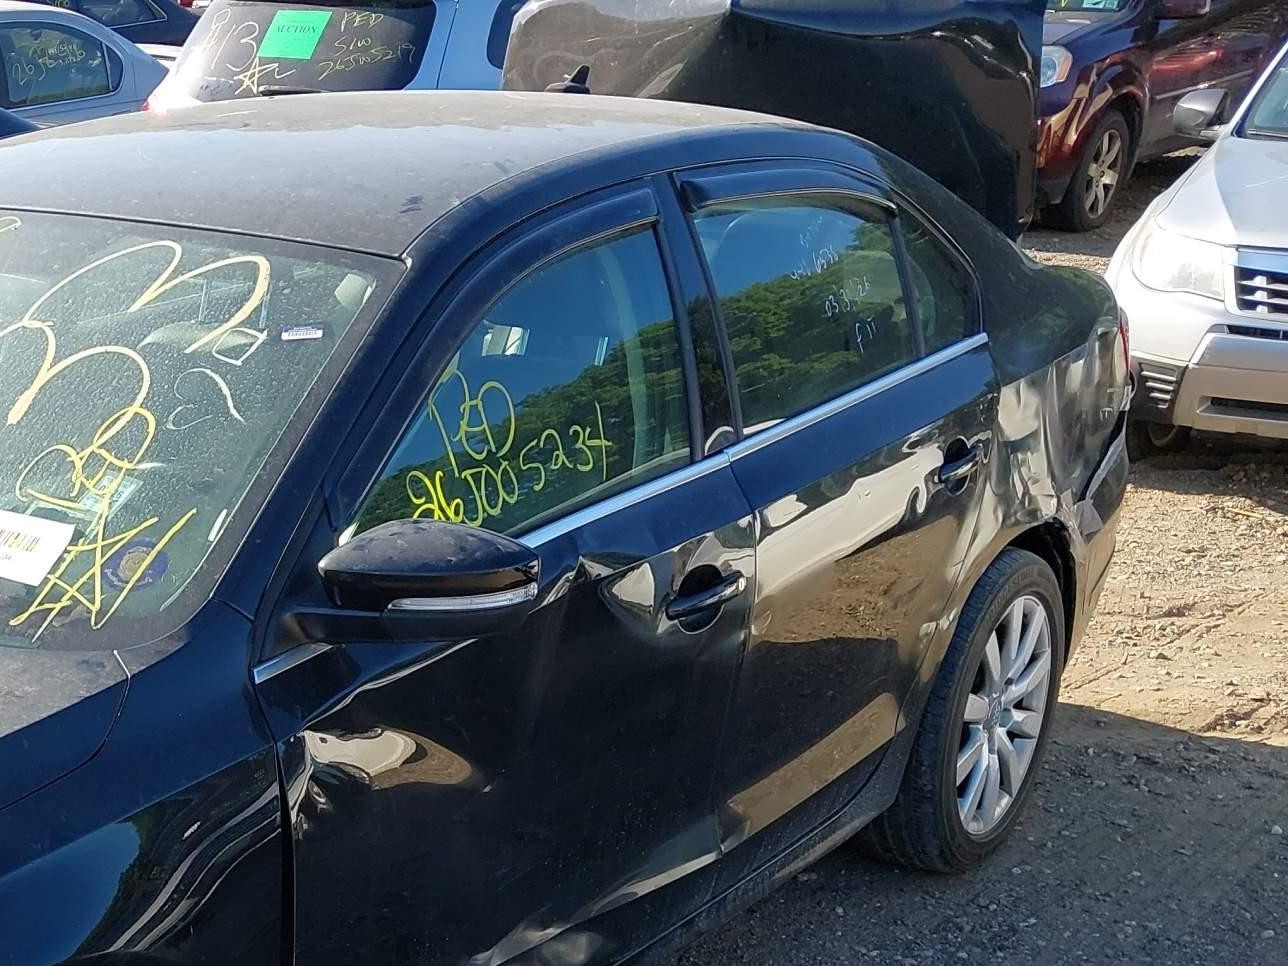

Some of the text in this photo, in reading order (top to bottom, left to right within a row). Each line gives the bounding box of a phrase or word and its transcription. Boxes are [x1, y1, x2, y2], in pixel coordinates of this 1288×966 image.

[275, 24, 318, 34] AUCTION
[340, 11, 383, 32] PED
[405, 400, 613, 528] 26J005234
